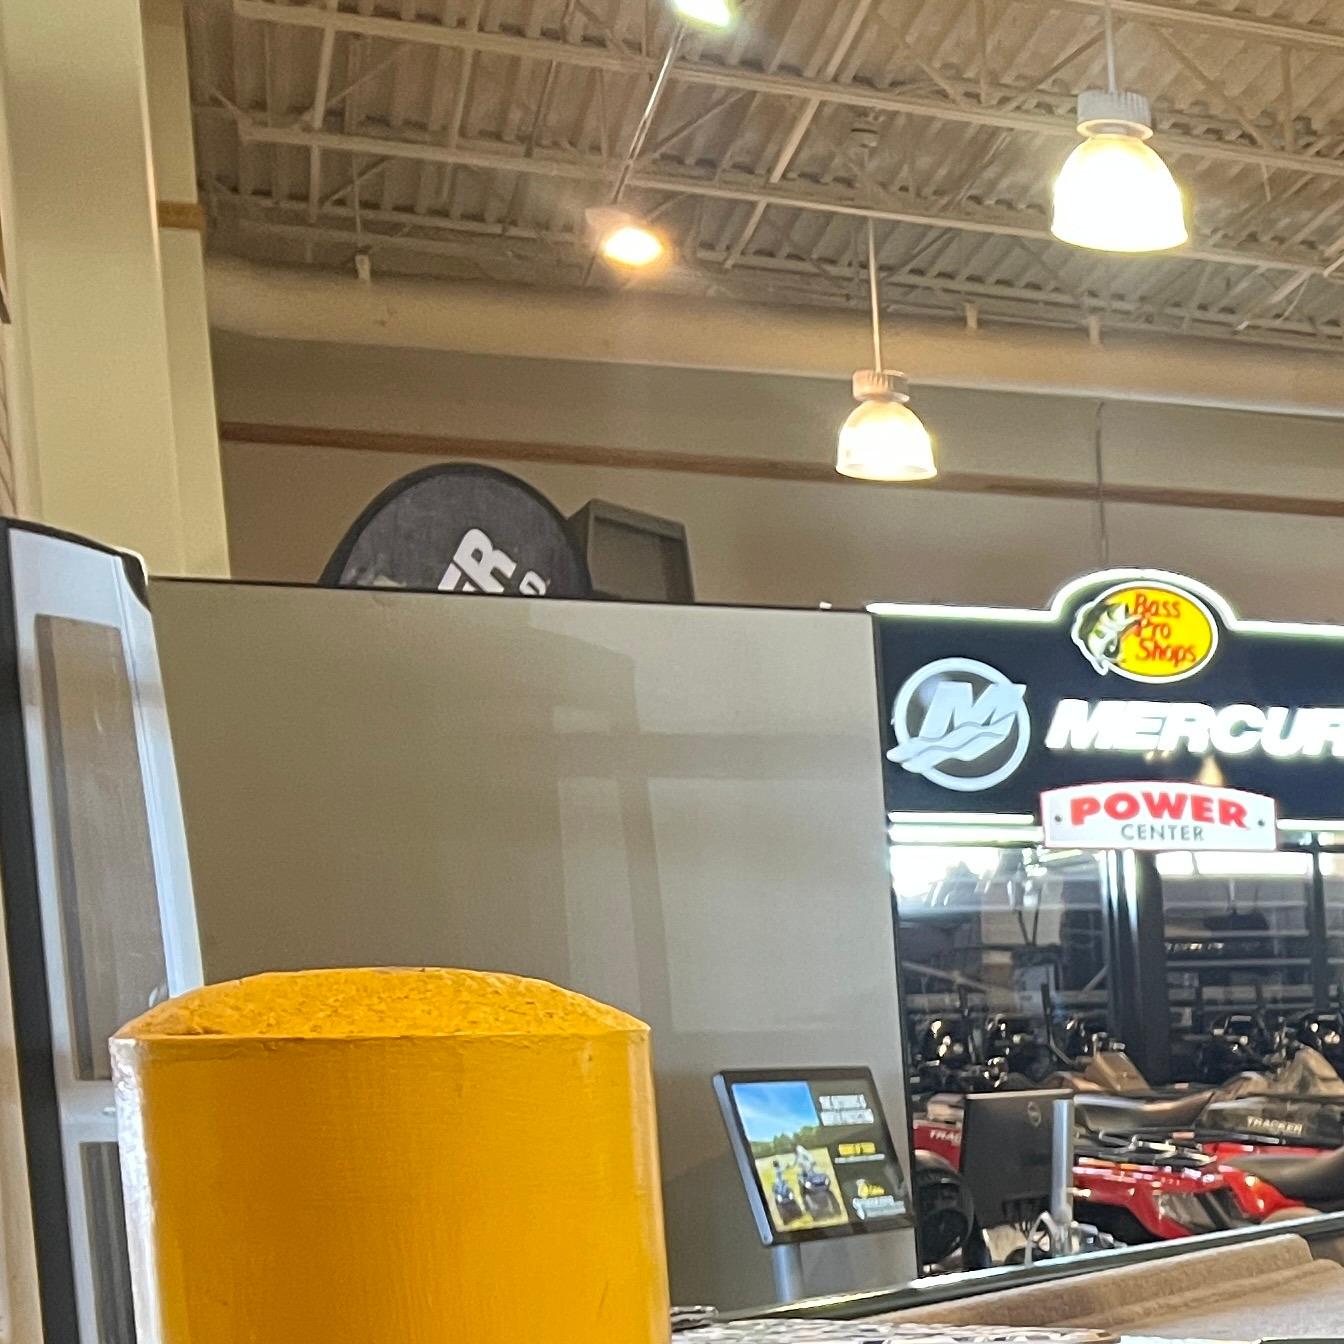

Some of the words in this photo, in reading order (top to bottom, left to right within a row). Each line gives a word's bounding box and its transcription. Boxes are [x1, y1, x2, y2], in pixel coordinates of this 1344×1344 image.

[1134, 593, 1181, 618] Bass
[1134, 618, 1172, 641] Pro
[1136, 638, 1197, 667] Shops
[1070, 790, 1250, 830] POWER
[1121, 824, 1205, 841] CENTER
[1247, 1115, 1302, 1135] TRACKER
